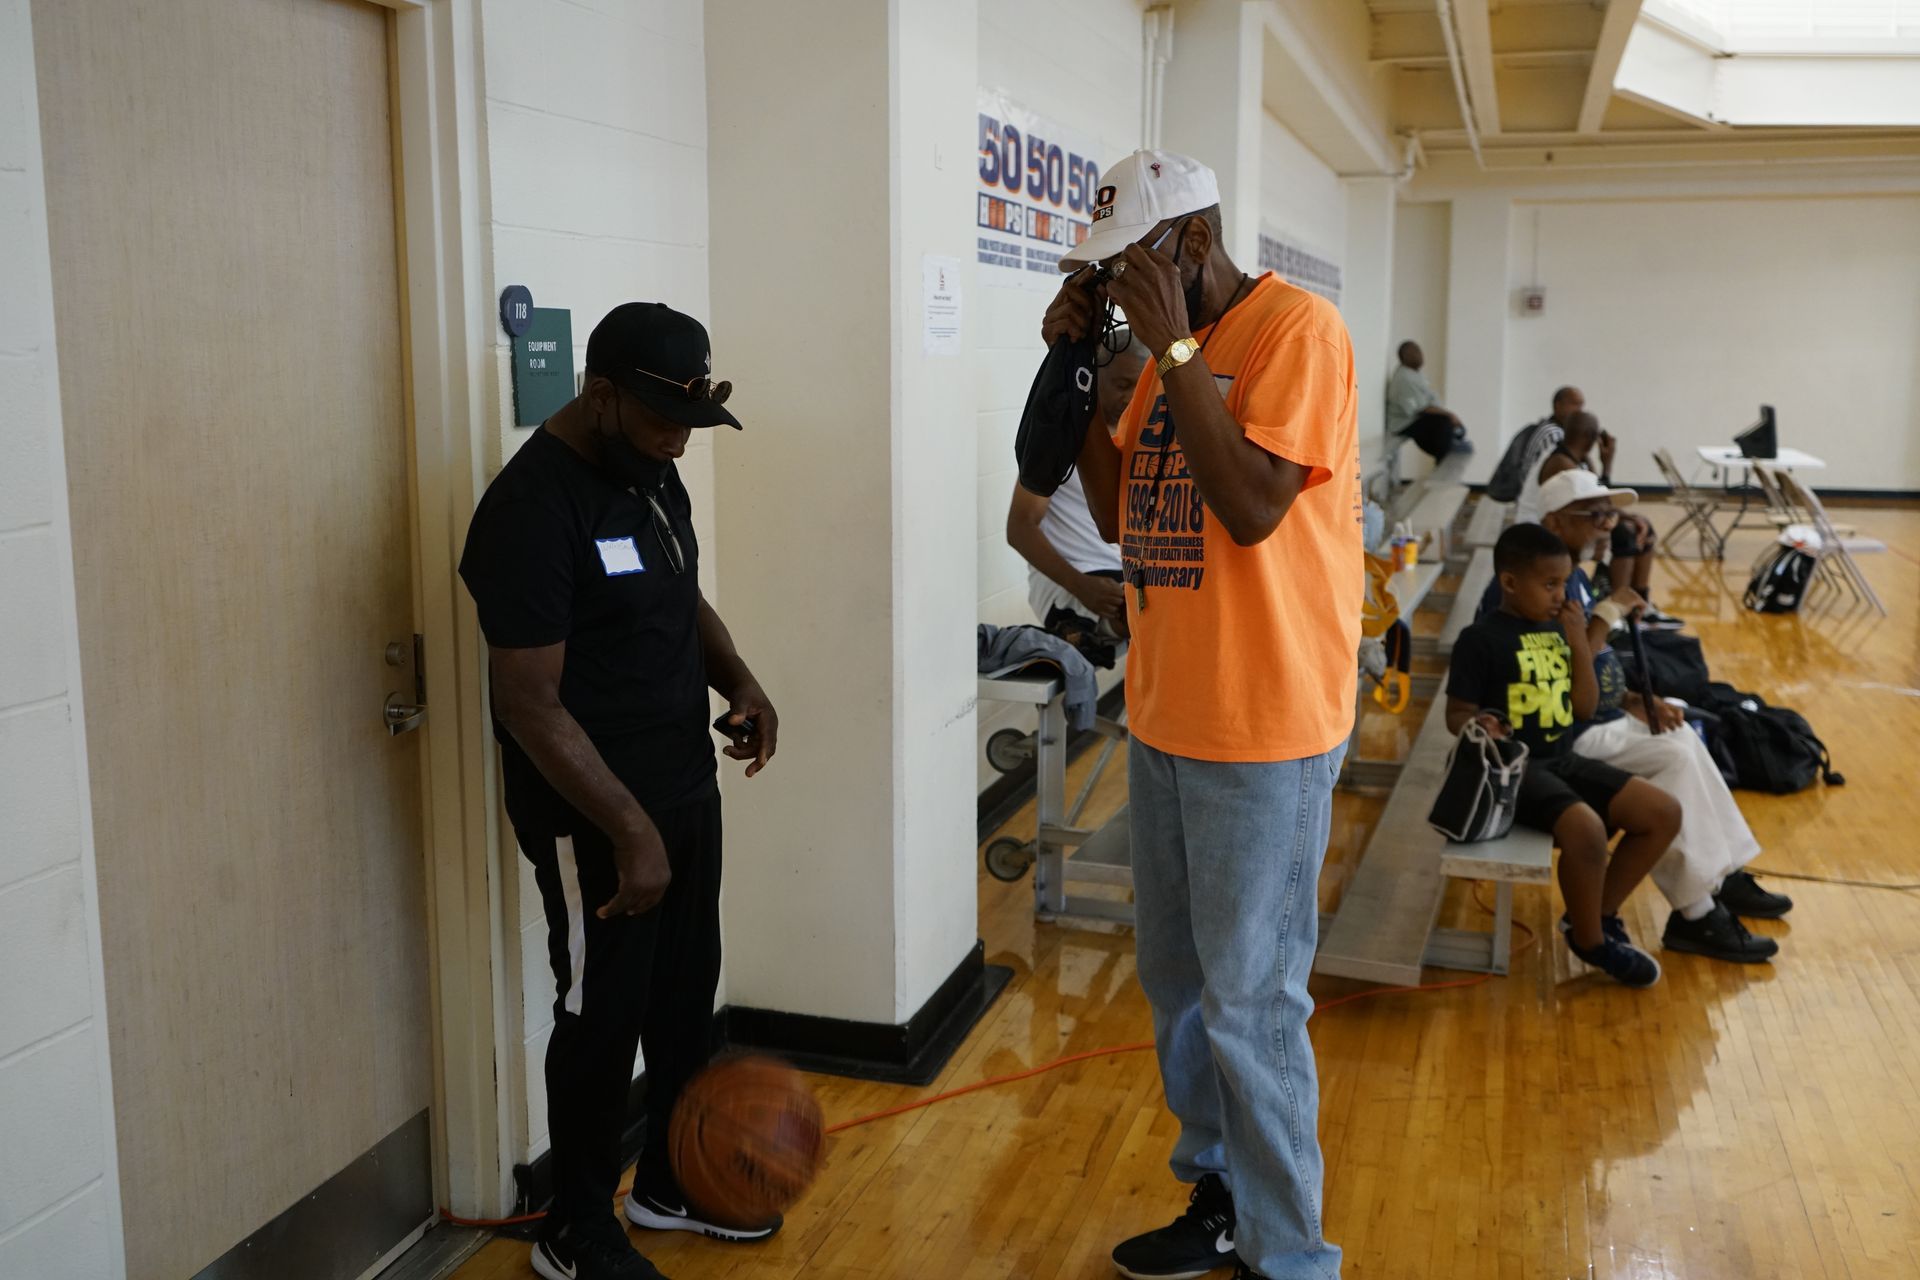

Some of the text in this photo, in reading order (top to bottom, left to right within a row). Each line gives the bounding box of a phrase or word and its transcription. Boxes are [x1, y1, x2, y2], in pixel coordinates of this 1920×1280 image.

[979, 113, 1099, 216] 50 50 50
[515, 303, 527, 319] 118
[528, 341, 557, 352] EQUIPMENT
[530, 359, 546, 369] ROOM
[1133, 452, 1189, 478] HOOP
[1171, 537, 1204, 547] AWARENESS
[1160, 548, 1181, 561] HEALTH
[1183, 549, 1204, 562] FAIRS
